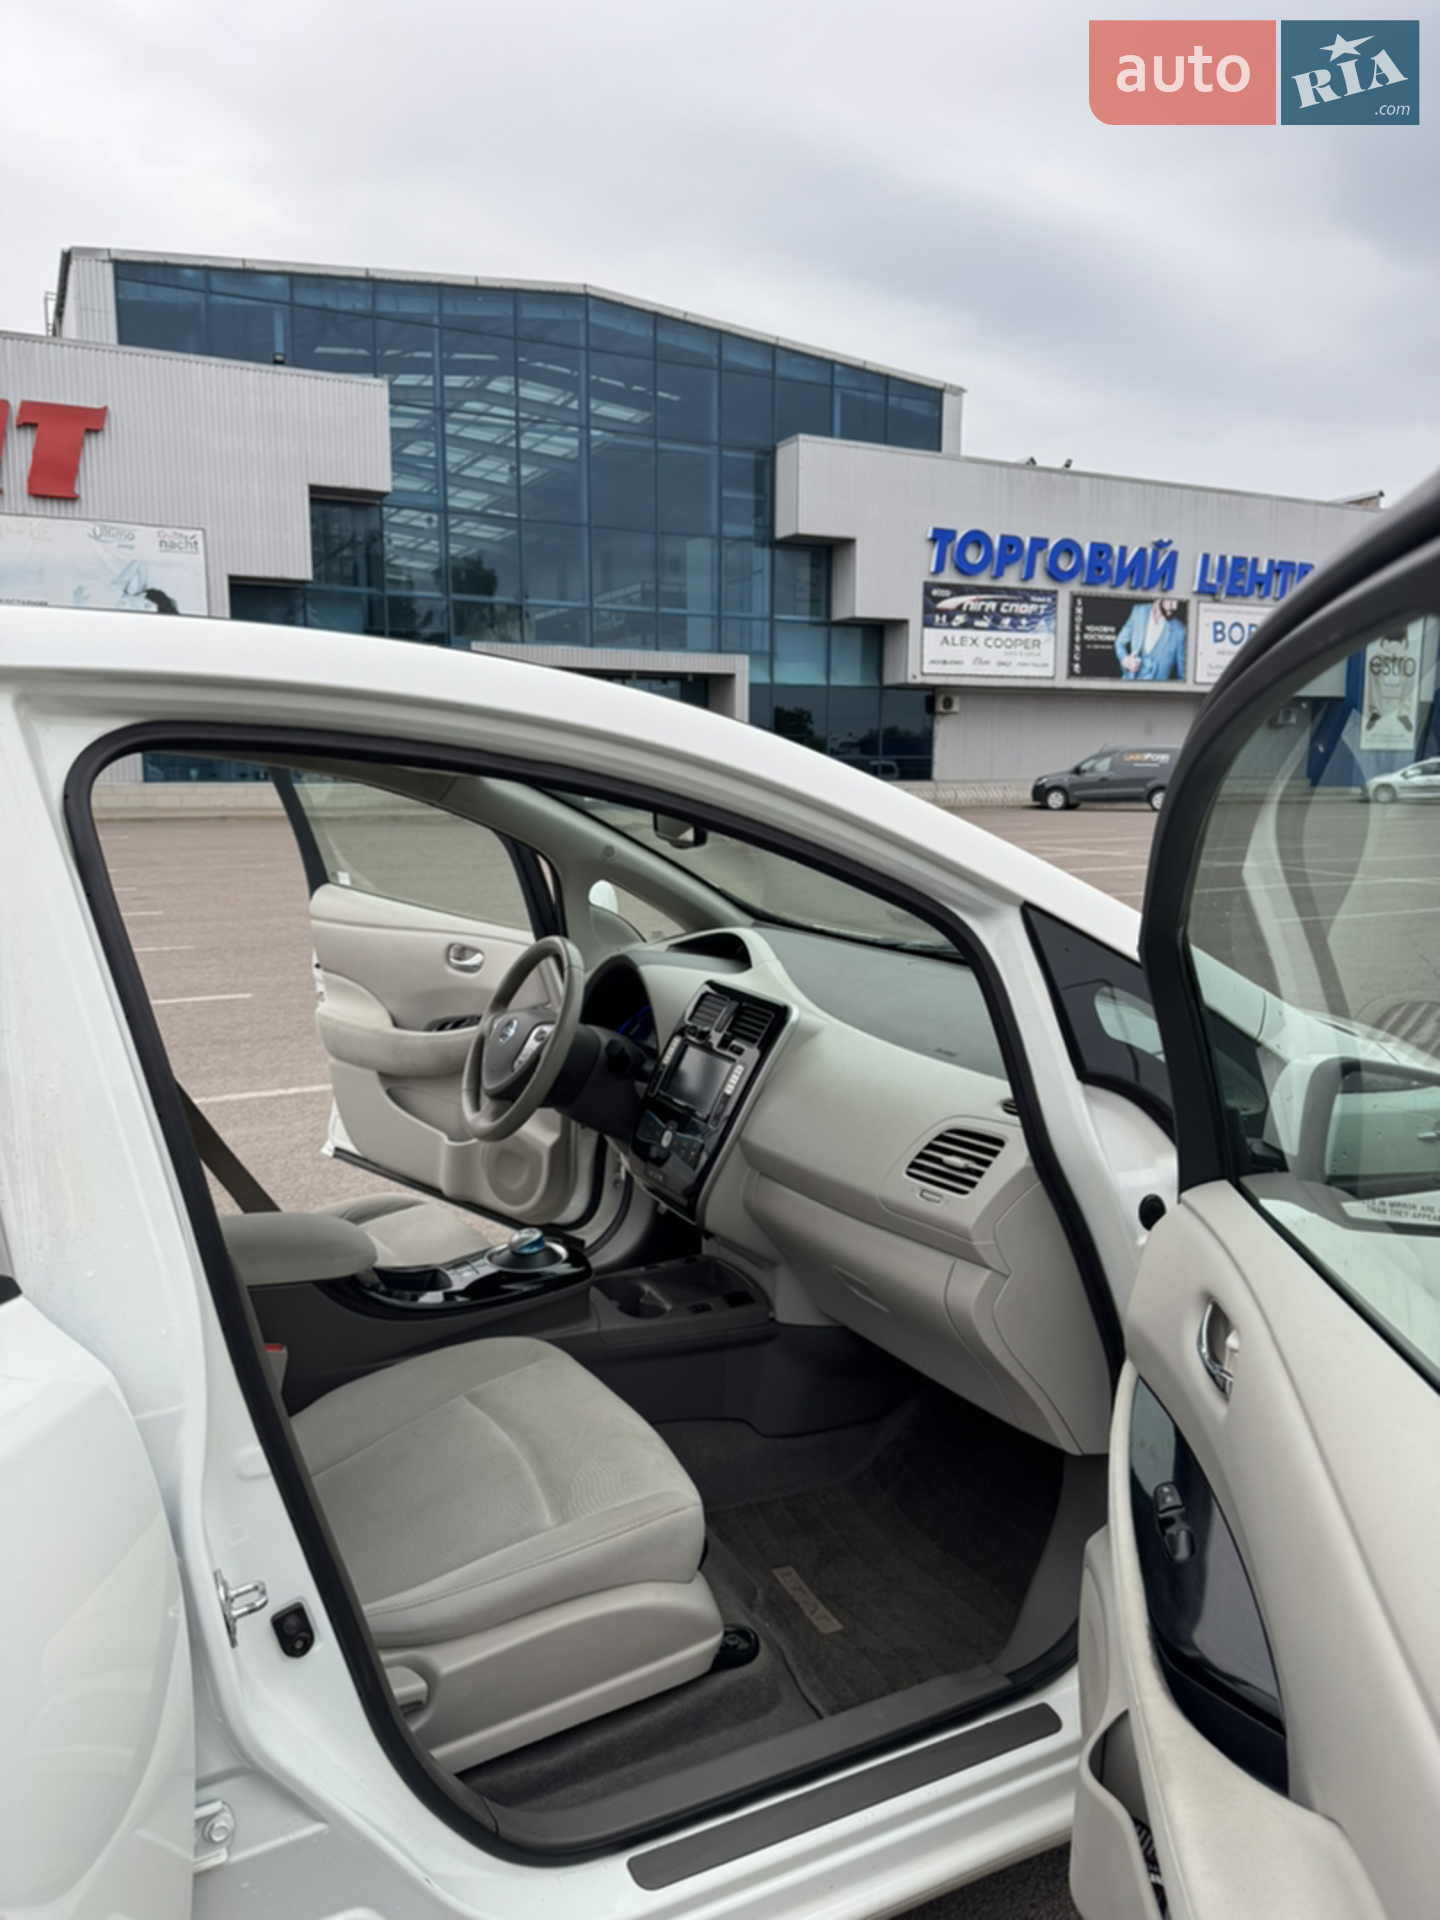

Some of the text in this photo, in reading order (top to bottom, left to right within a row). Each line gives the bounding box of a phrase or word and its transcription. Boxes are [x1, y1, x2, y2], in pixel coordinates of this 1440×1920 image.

[927, 526, 1179, 591] ТОРГОВИЙ
[940, 636, 1042, 650] ALEX COOPER
[1369, 653, 1417, 678] estro
